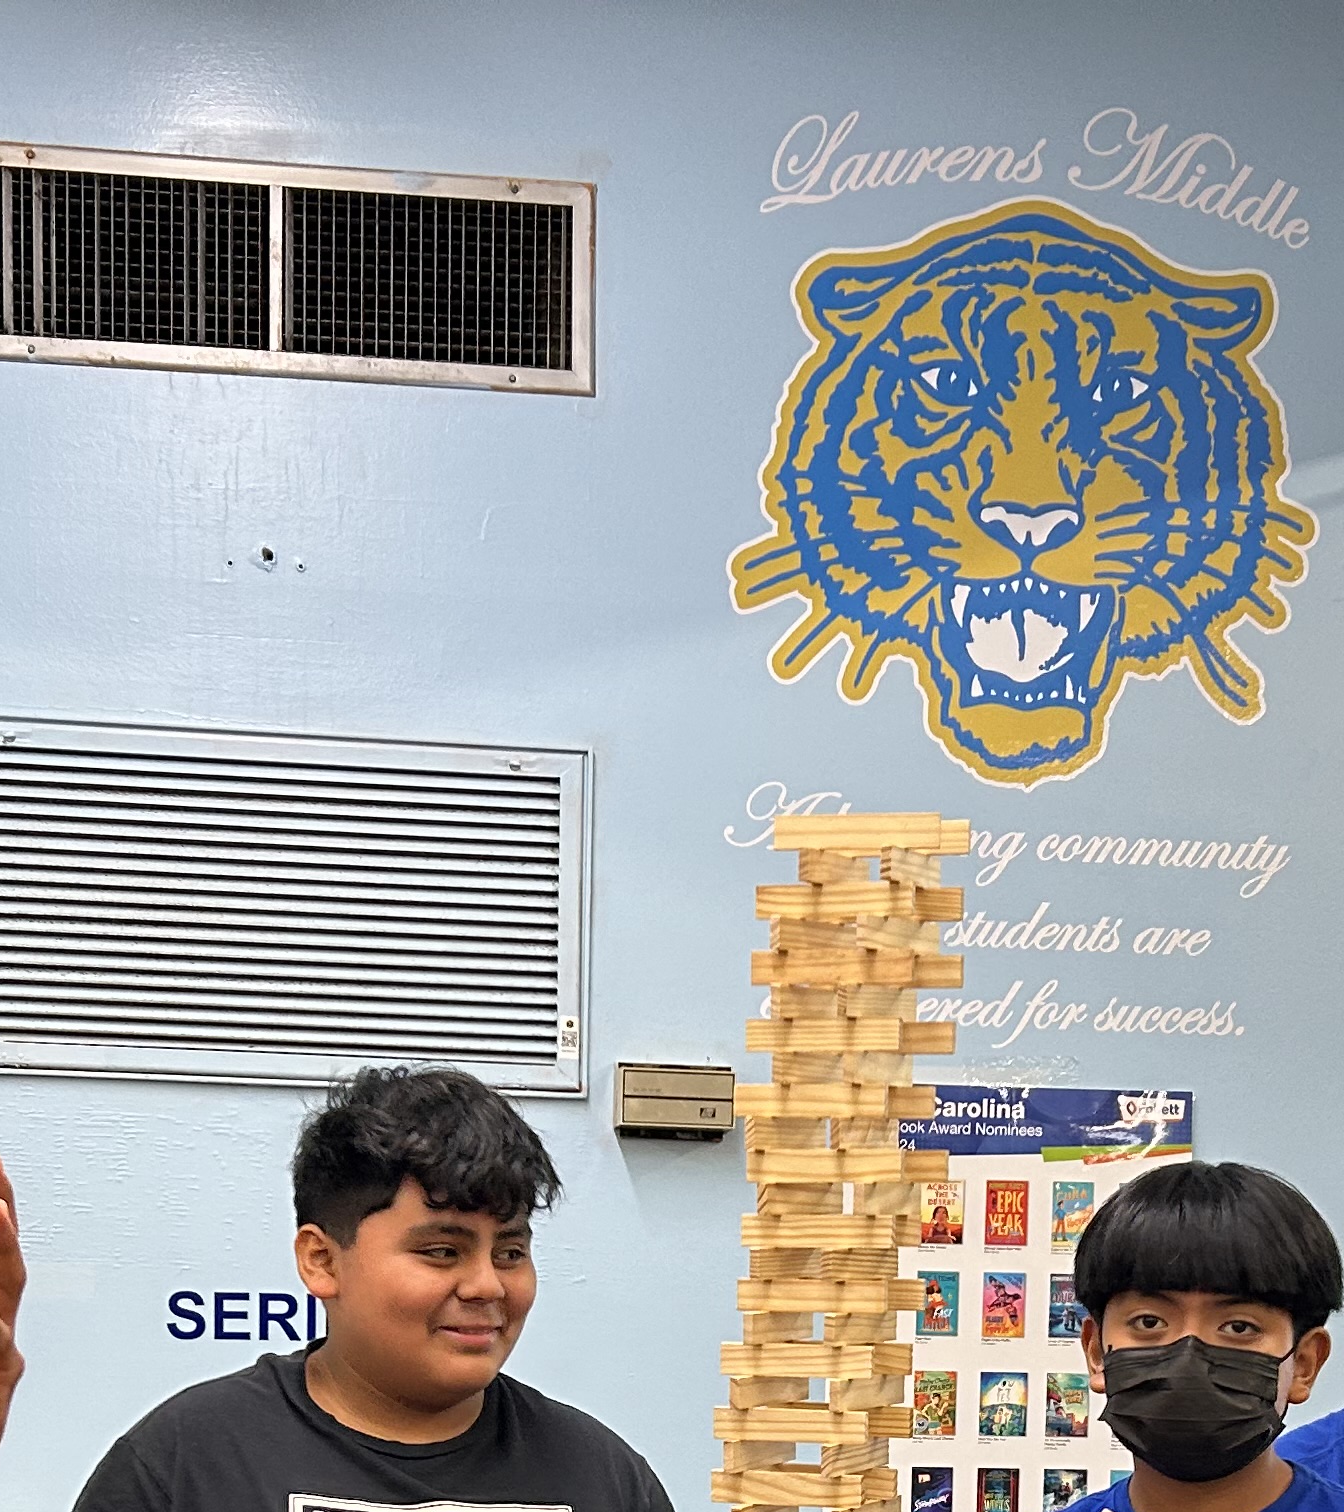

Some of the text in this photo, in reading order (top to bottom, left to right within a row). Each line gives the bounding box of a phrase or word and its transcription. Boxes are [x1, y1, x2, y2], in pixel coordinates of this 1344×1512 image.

[759, 107, 1310, 248] Laurens Middle
[1036, 832, 1290, 898] community
[943, 903, 1212, 957] students are
[992, 980, 1087, 1048] for
[1094, 995, 1245, 1036] success.
[900, 1120, 1043, 1137] ook Award Nominees
[997, 1191, 1024, 1213] EPIC
[166, 1290, 327, 1341] SERI
